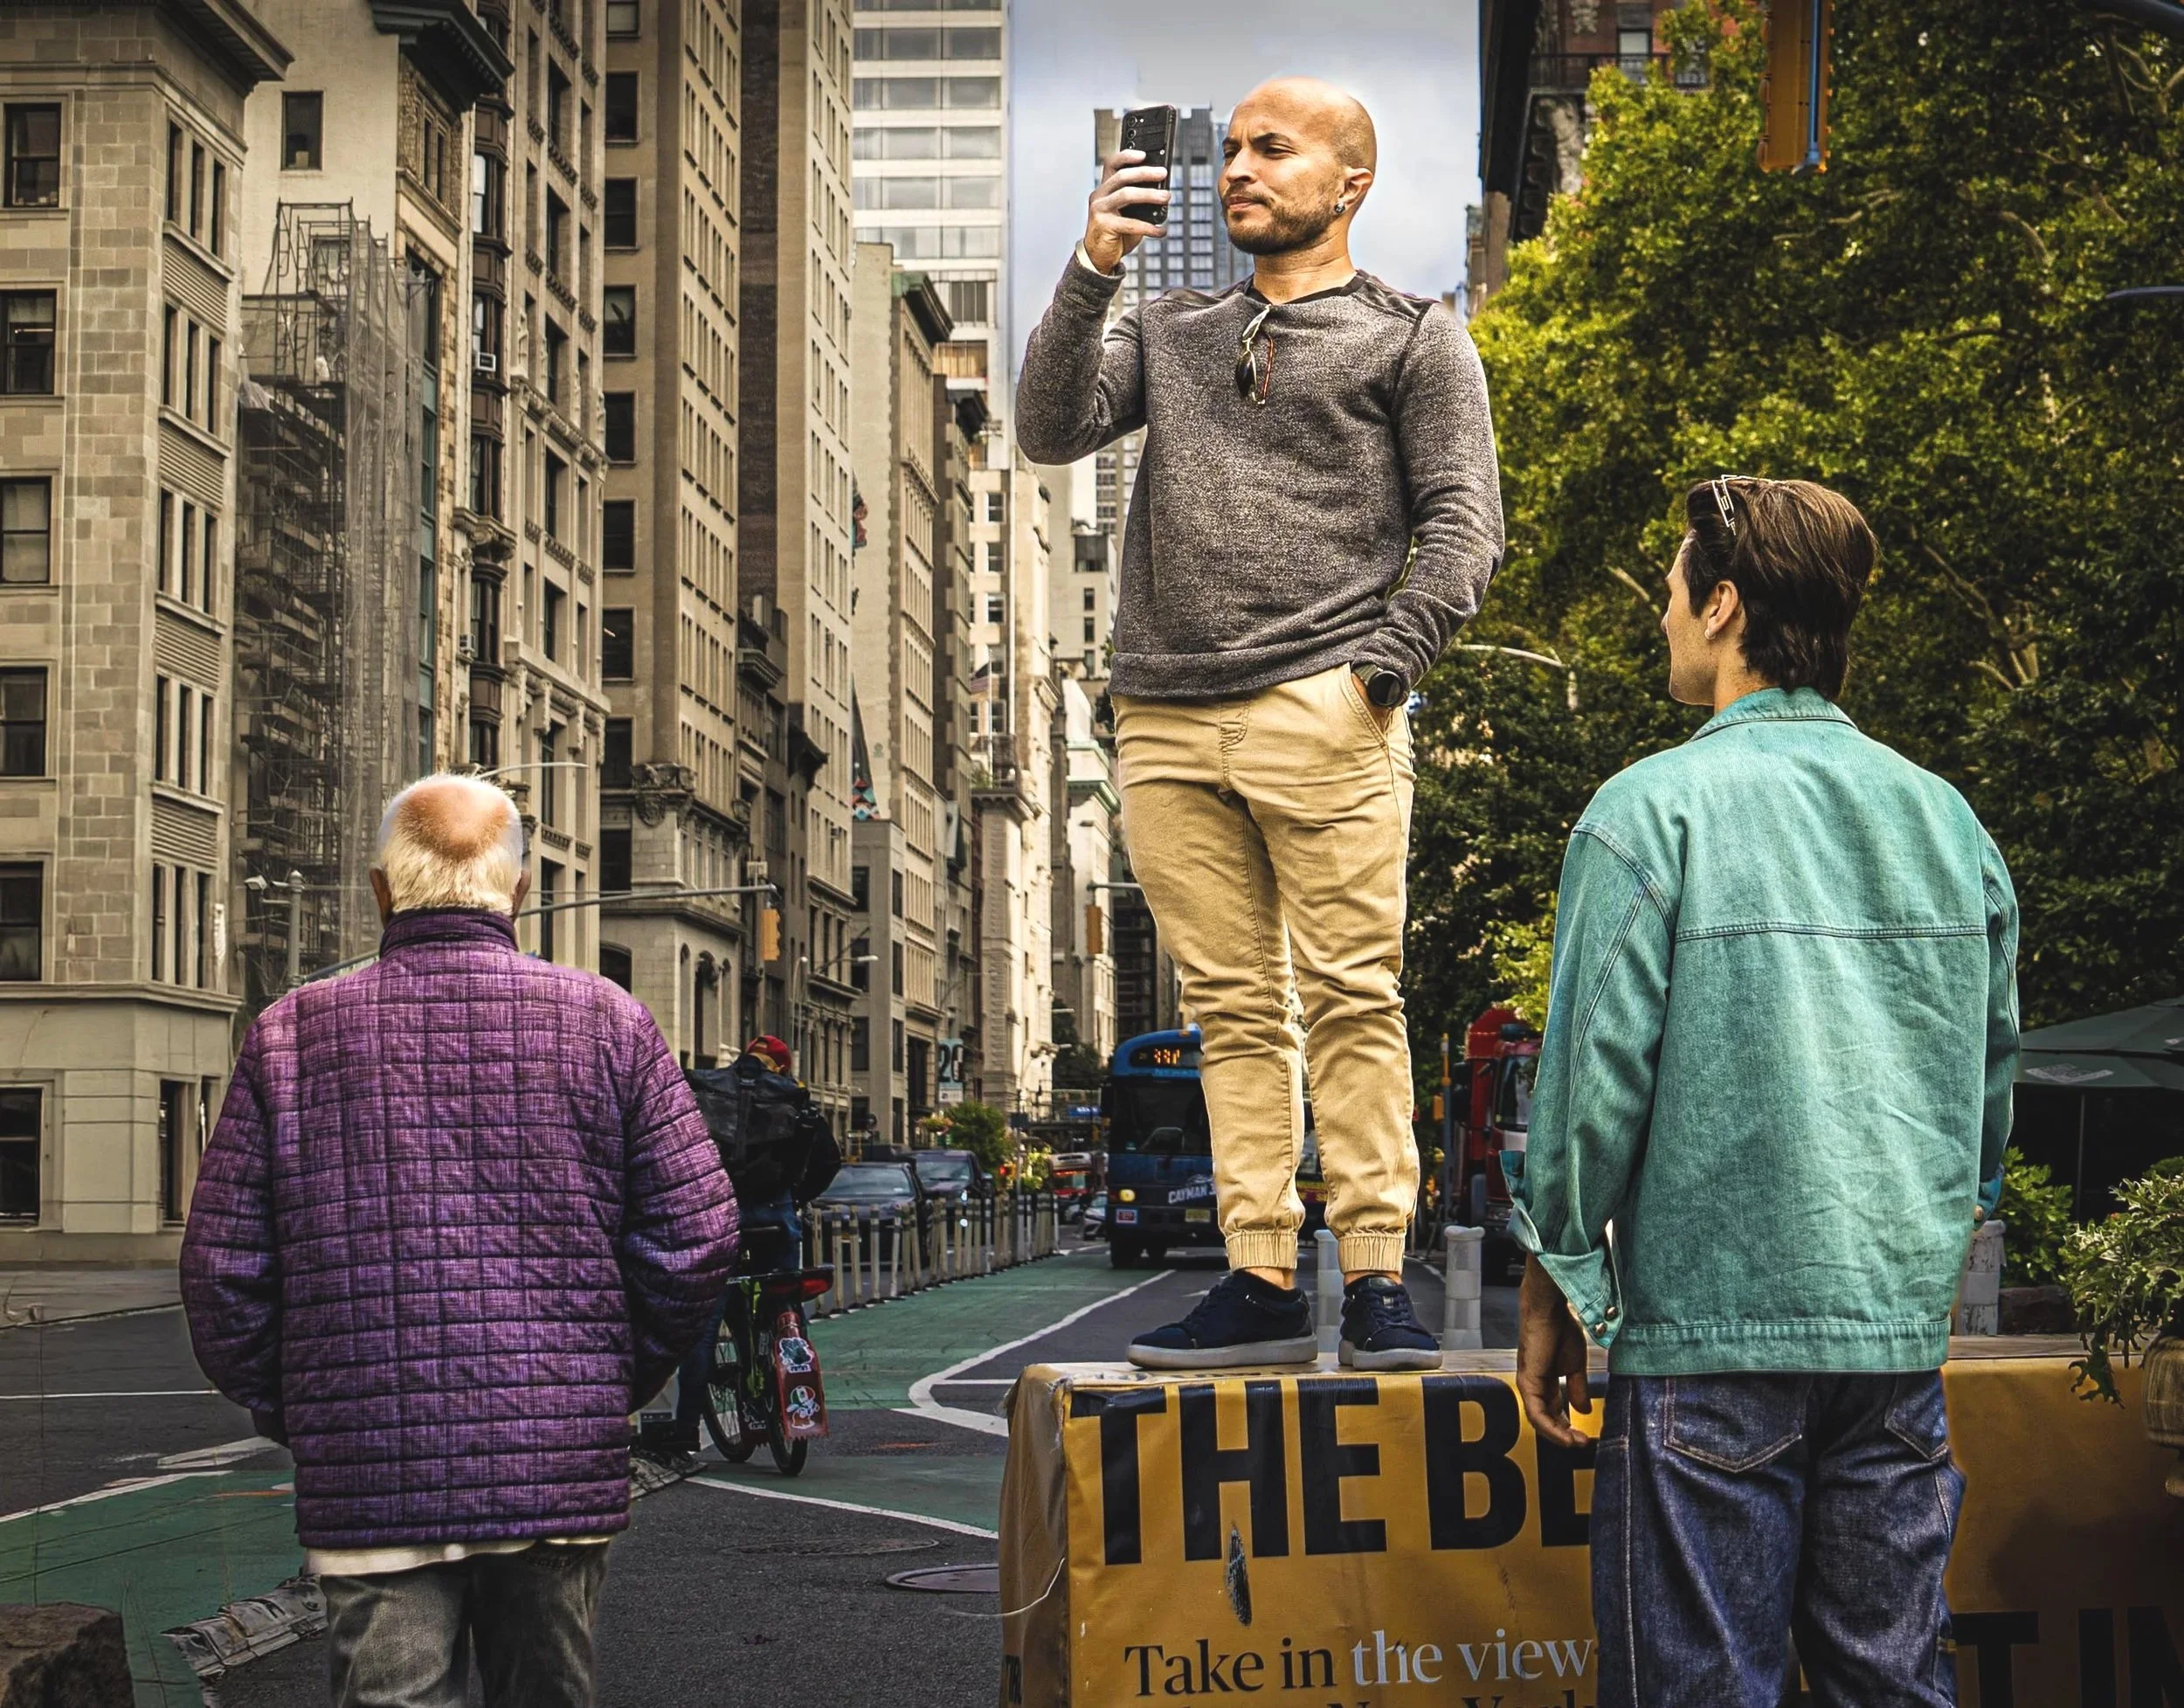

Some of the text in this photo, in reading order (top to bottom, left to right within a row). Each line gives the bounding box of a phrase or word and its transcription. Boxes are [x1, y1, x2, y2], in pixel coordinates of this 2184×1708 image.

[1069, 1377, 1387, 1566] THE
[1124, 1628, 1595, 1698] Take in the view
